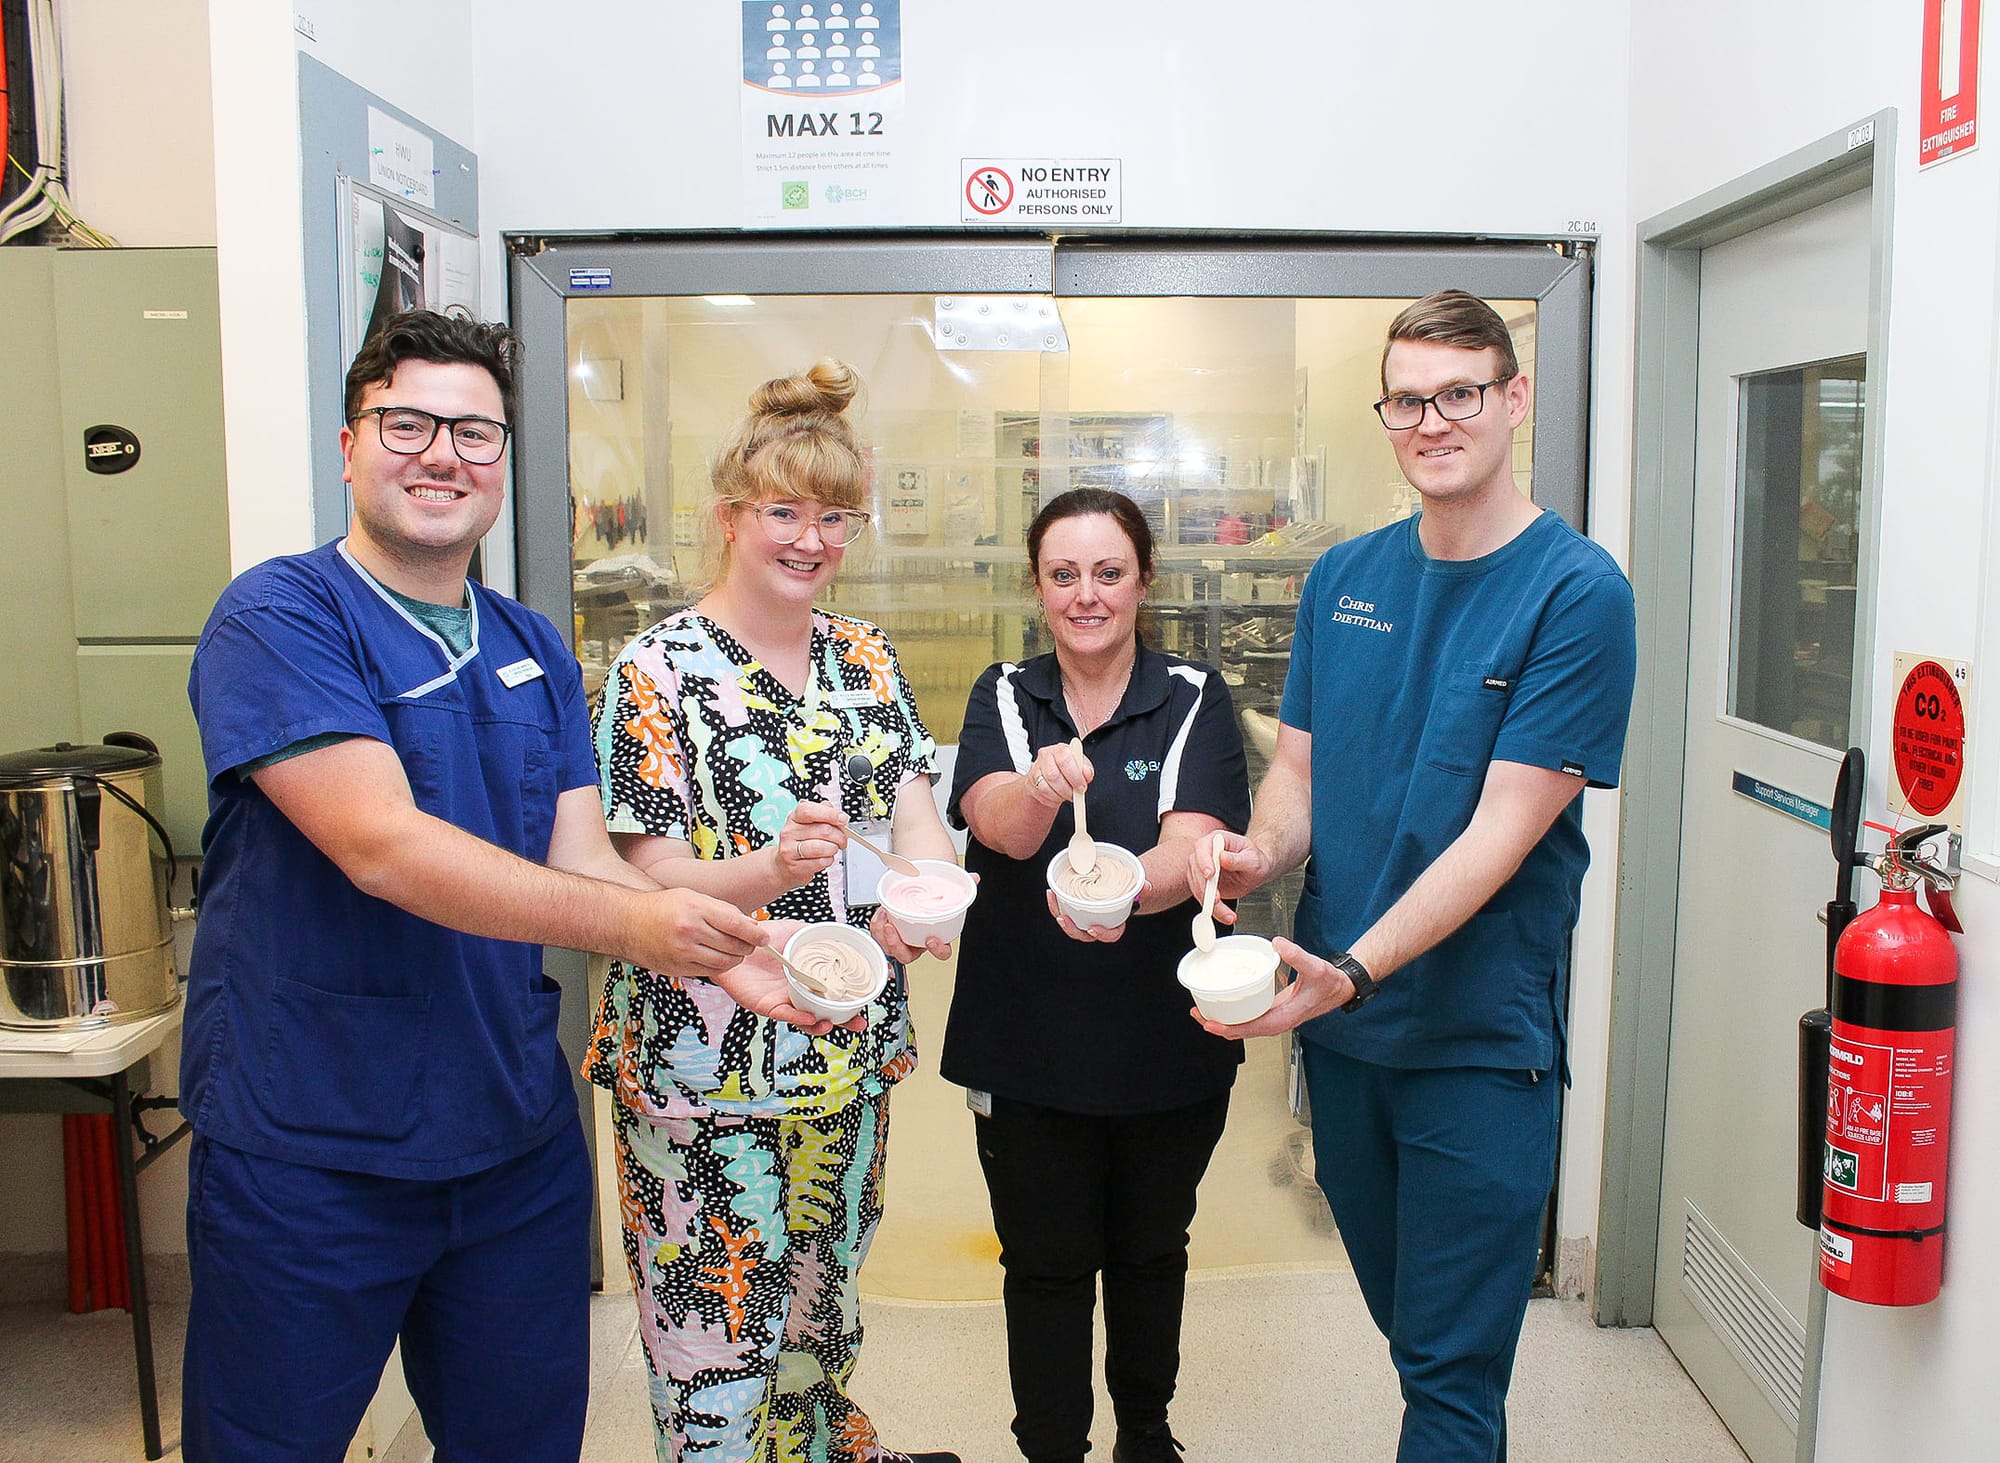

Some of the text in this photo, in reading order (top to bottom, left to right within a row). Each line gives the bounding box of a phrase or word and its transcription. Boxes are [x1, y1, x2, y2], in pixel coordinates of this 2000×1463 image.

[1940, 104, 1957, 124] FIRE
[767, 112, 884, 137] MAX 12
[1922, 120, 1974, 153] EXTINGUISHER
[797, 152, 819, 160] people
[377, 163, 429, 197] UNION NOTICEBOARD
[1021, 168, 1111, 182] NO ENTRY
[845, 188, 867, 198] BCH
[1026, 189, 1106, 199] AUTHORISED
[1018, 205, 1114, 215] PERSONS ONLY
[1567, 220, 1596, 232] 2C.04
[92, 444, 117, 455] NHP
[1331, 611, 1393, 633] DIETITIAN
[1903, 674, 1917, 697] THIS
[1754, 782, 1819, 818] Support Services Manager
[1859, 1127, 1869, 1135] FIRE
